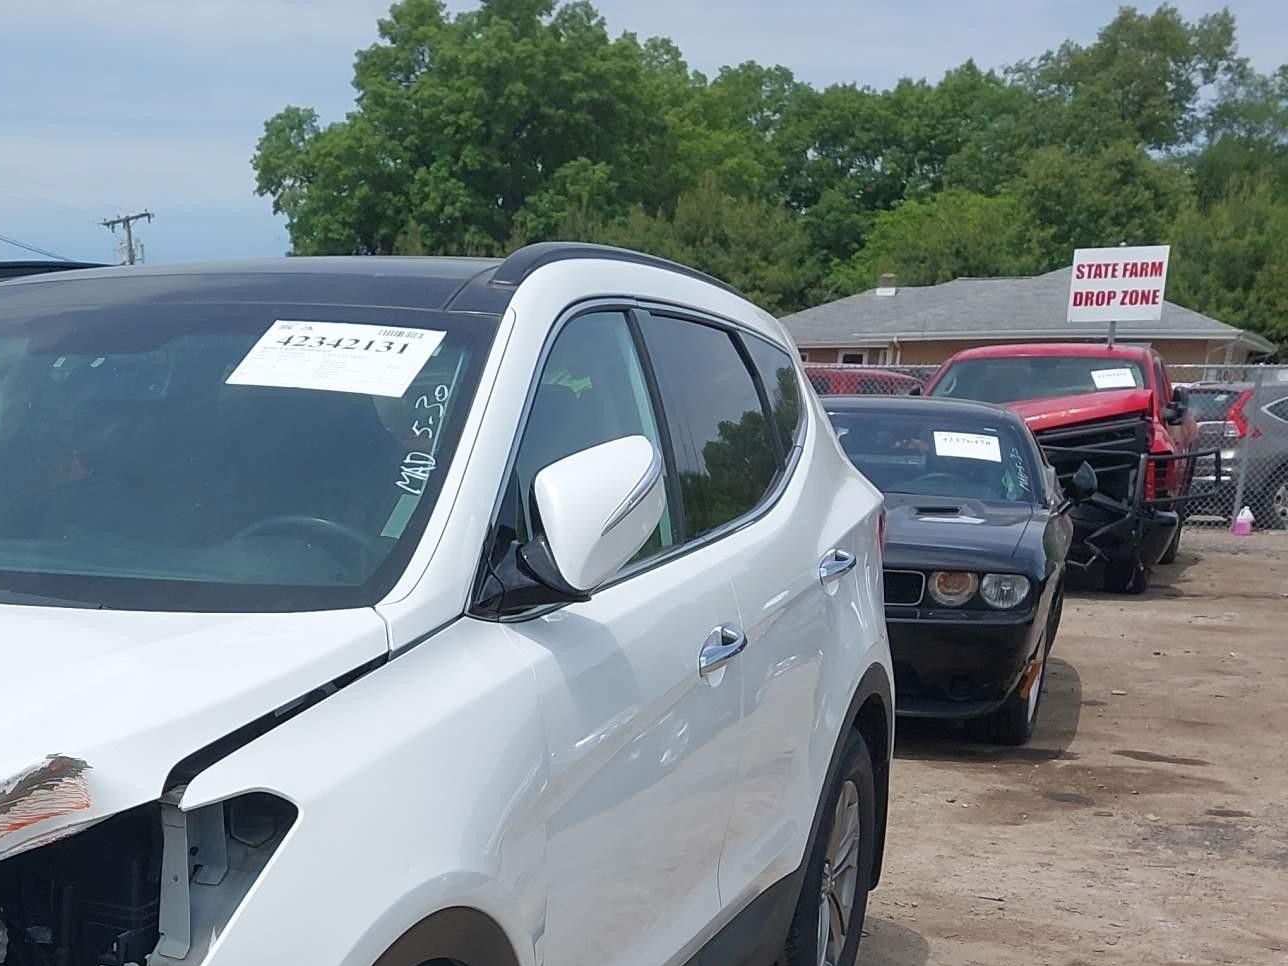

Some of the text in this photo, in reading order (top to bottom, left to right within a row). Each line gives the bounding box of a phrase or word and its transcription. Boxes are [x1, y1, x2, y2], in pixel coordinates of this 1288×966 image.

[1076, 261, 1164, 279] STATE FARM
[1072, 289, 1161, 307] DROP ZONE
[276, 334, 411, 355] 42342131
[395, 451, 437, 495] MAD
